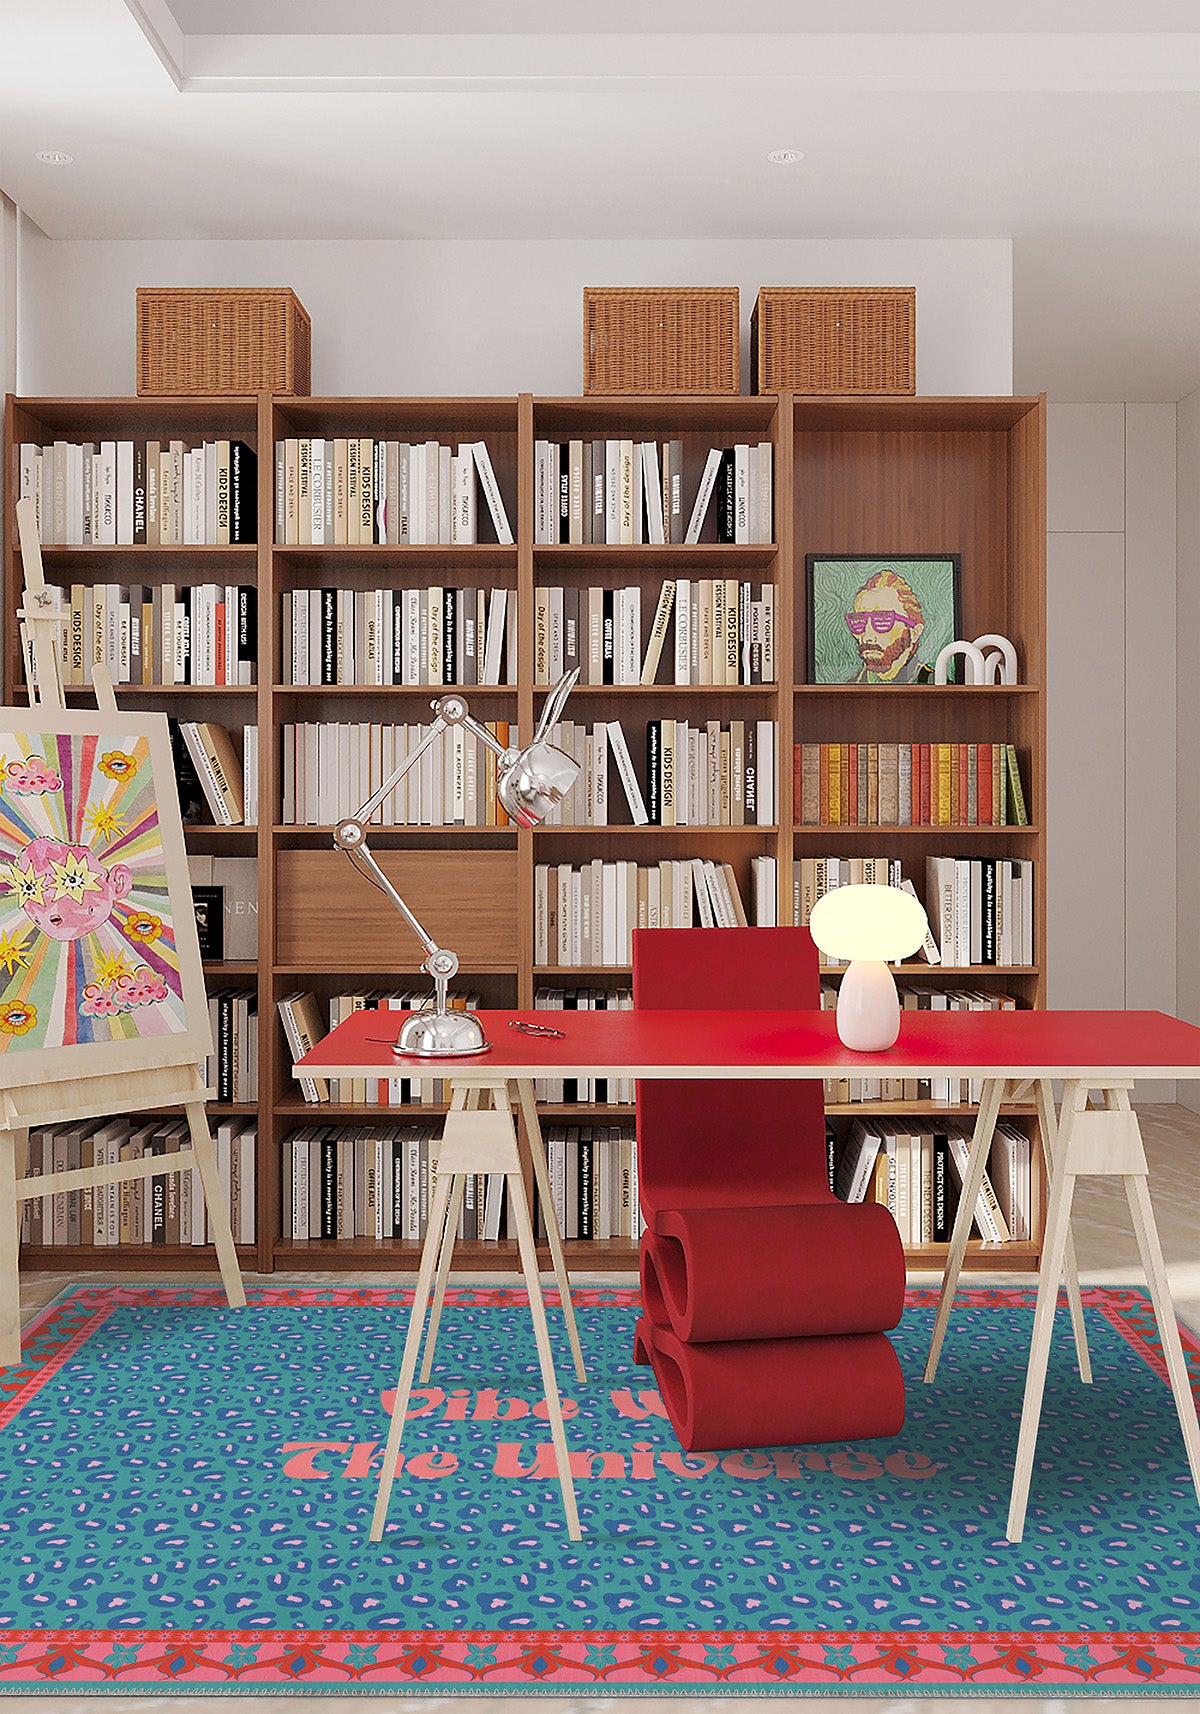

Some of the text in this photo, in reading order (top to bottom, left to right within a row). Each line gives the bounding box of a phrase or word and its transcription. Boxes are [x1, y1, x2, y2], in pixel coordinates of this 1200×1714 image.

[300, 443, 308, 497] DESIGN FESTIVAL
[312, 458, 322, 530] LE CORBUSIER
[349, 443, 357, 497] DESIGN FESTIVAL
[622, 456, 631, 527] Day of the design
[135, 488, 145, 533] CHANEL
[362, 467, 371, 526] KIDS DESIGN
[561, 474, 569, 517] COFFEE ATLAS
[95, 604, 103, 619] Day
[96, 620, 103, 630] of
[120, 620, 127, 629] BE
[176, 621, 182, 630] BE
[431, 606, 439, 621] Day
[432, 622, 439, 631] of
[654, 585, 673, 638] DESIGN FESTIVAL
[678, 599, 688, 671] LE CORBUSIER
[764, 606, 770, 616] BE
[73, 611, 82, 668] KIDS DESIGN
[431, 647, 439, 673] design
[537, 606, 546, 673] Day of the design
[728, 607, 736, 668] KIDS DESIGN
[663, 747, 672, 806] KIDS DESIGN
[944, 884, 953, 944] BETTER DESIGN
[154, 1185, 163, 1230] CHANEL
[923, 1170, 932, 1239] THE NEXT DESIGN
[379, 1388, 581, 1421] Vibe
[281, 1441, 938, 1479] The Universe
